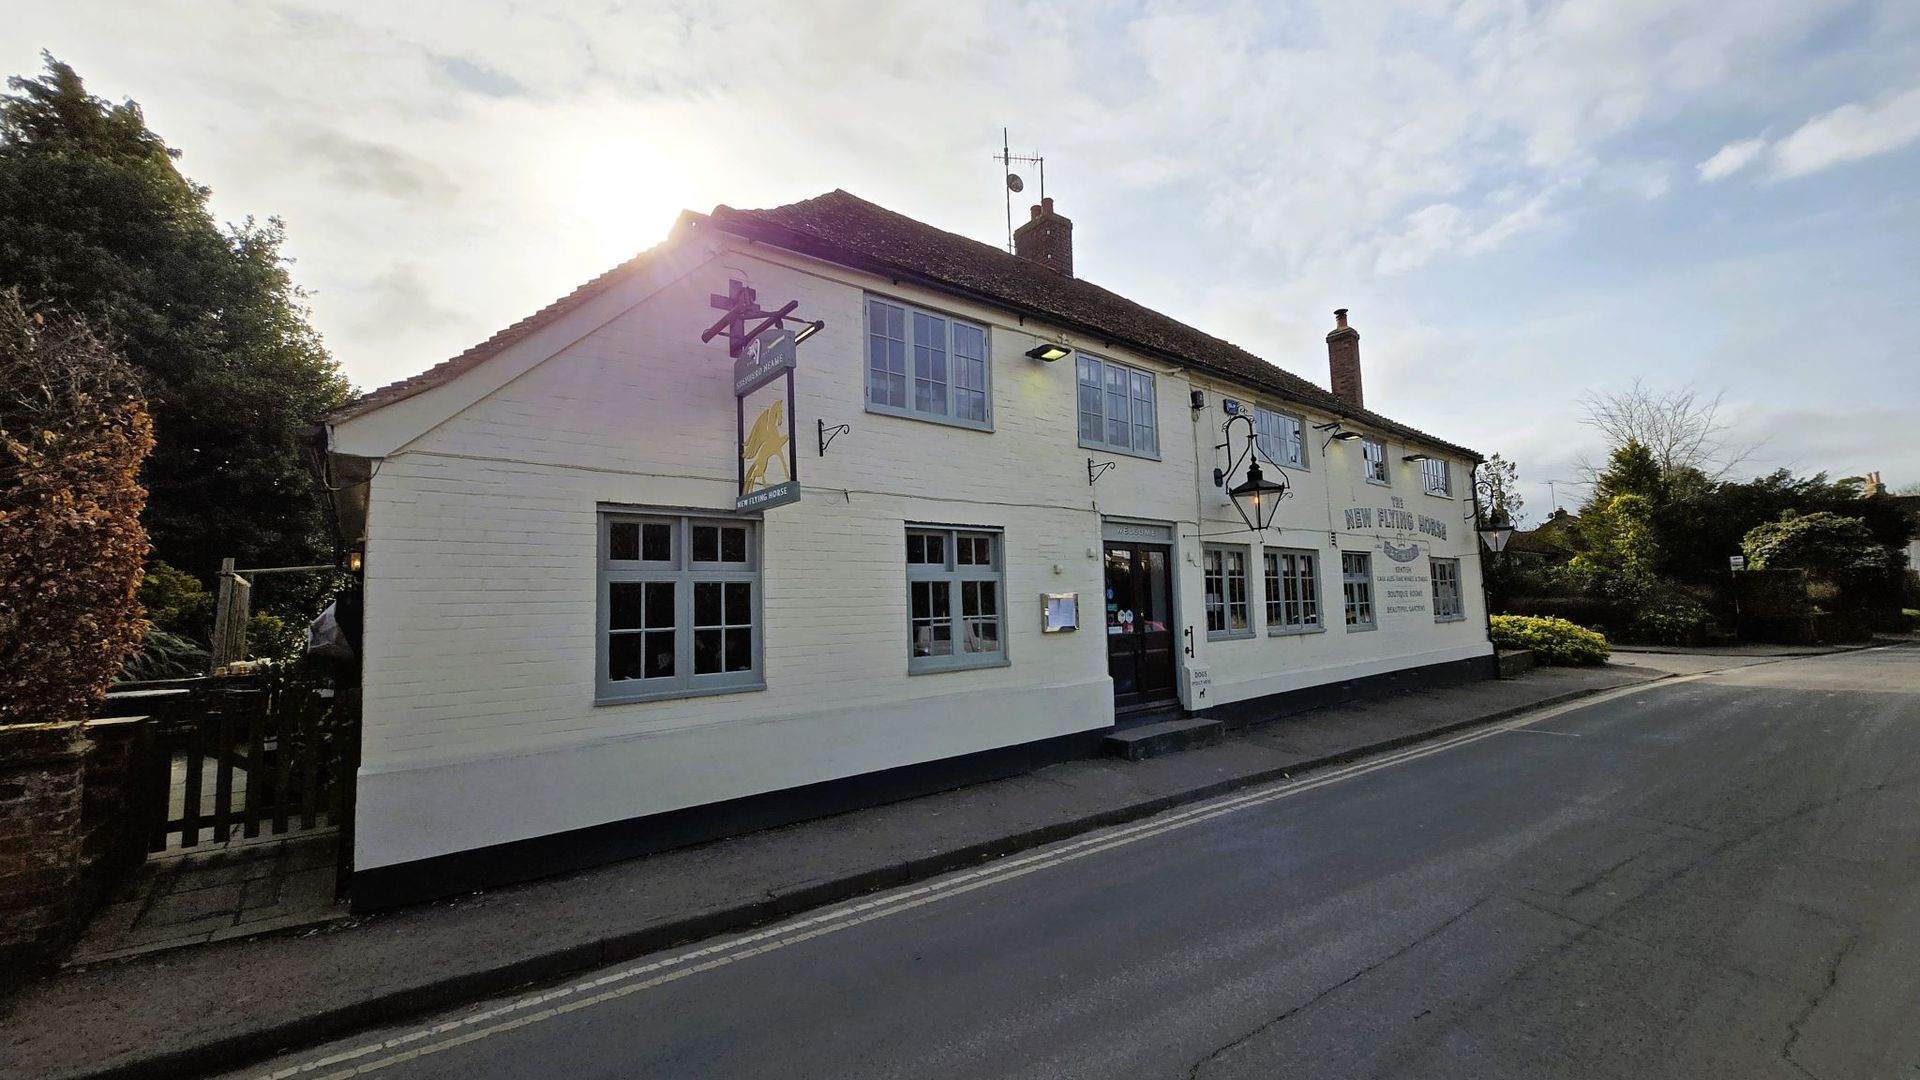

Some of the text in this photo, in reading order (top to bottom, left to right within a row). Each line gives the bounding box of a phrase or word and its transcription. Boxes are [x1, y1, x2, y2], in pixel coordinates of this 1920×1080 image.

[736, 353, 784, 388] SHEPHERD NEAME
[737, 487, 788, 508] NEW FLYING HORSE
[1391, 495, 1404, 509] THE
[1344, 507, 1447, 541] NEW FLYING HORSE
[1117, 526, 1157, 537] WELCOME
[1387, 590, 1409, 598] BOUTIQUE
[1195, 671, 1208, 679] DOGS
